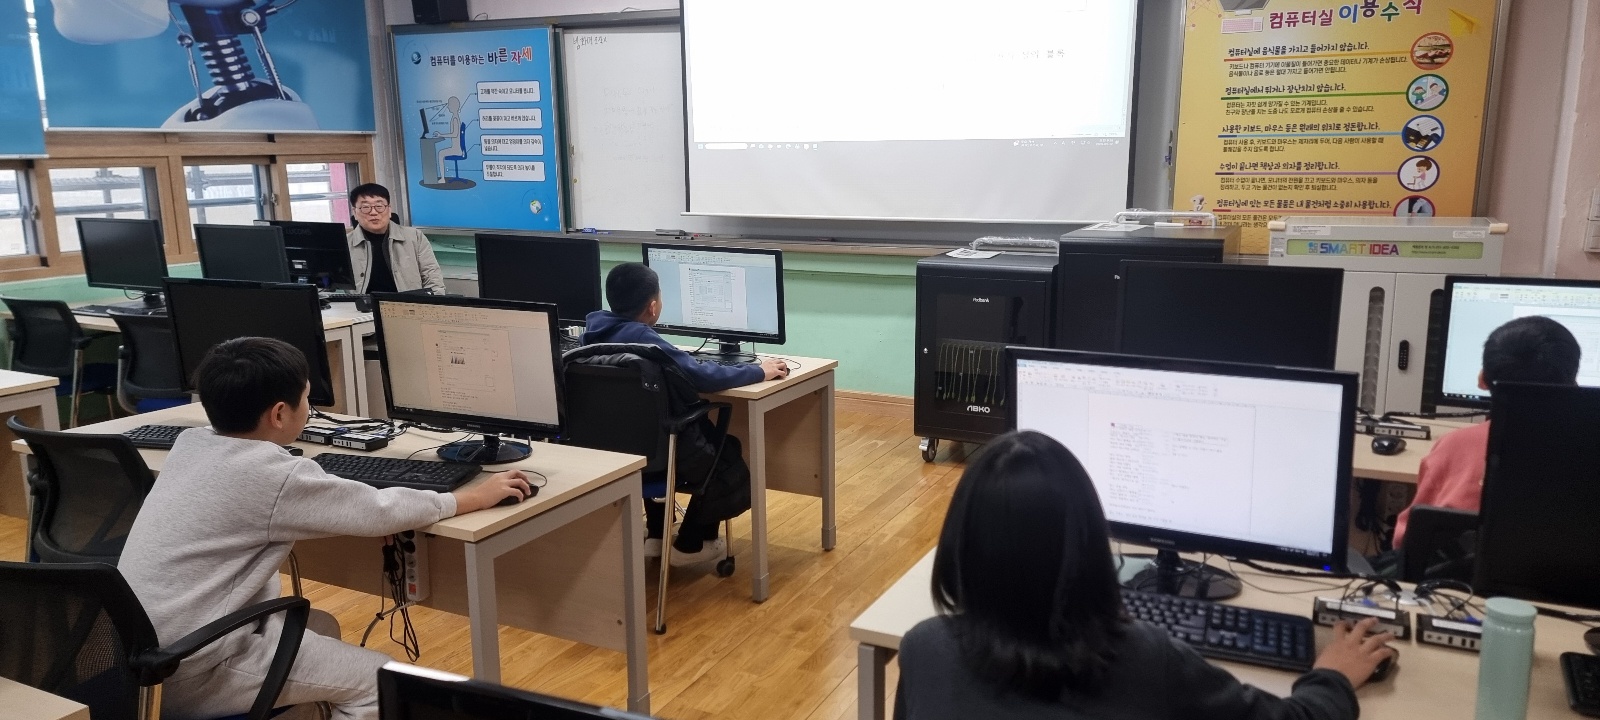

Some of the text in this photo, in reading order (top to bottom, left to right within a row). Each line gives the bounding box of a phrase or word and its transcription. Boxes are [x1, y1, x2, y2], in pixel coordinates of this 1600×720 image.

[1269, 9, 1334, 29] 컴퓨터실
[430, 46, 532, 66] 컴퓨터를 이용하는 바른 자세
[1228, 42, 1370, 57] 컴퓨터실에 음식물을 가지고 들어가지 않습니다.
[1225, 83, 1346, 95] 컴퓨터실에서 뛰거나 장난치지 않습니다.
[1222, 121, 1380, 133] 사용한 키보드, 마우스 등은 원래의 위치로 정돈합니다.
[1219, 161, 1340, 171] 수업이 끝나면 책상과 의자를 정리합니다.
[1217, 199, 1392, 209] 컴퓨터실에 있는 모든 물품은 내 물건처럼 소중히 사용합니다.
[1319, 242, 1367, 254] SMART
[1369, 243, 1400, 256] IDEA
